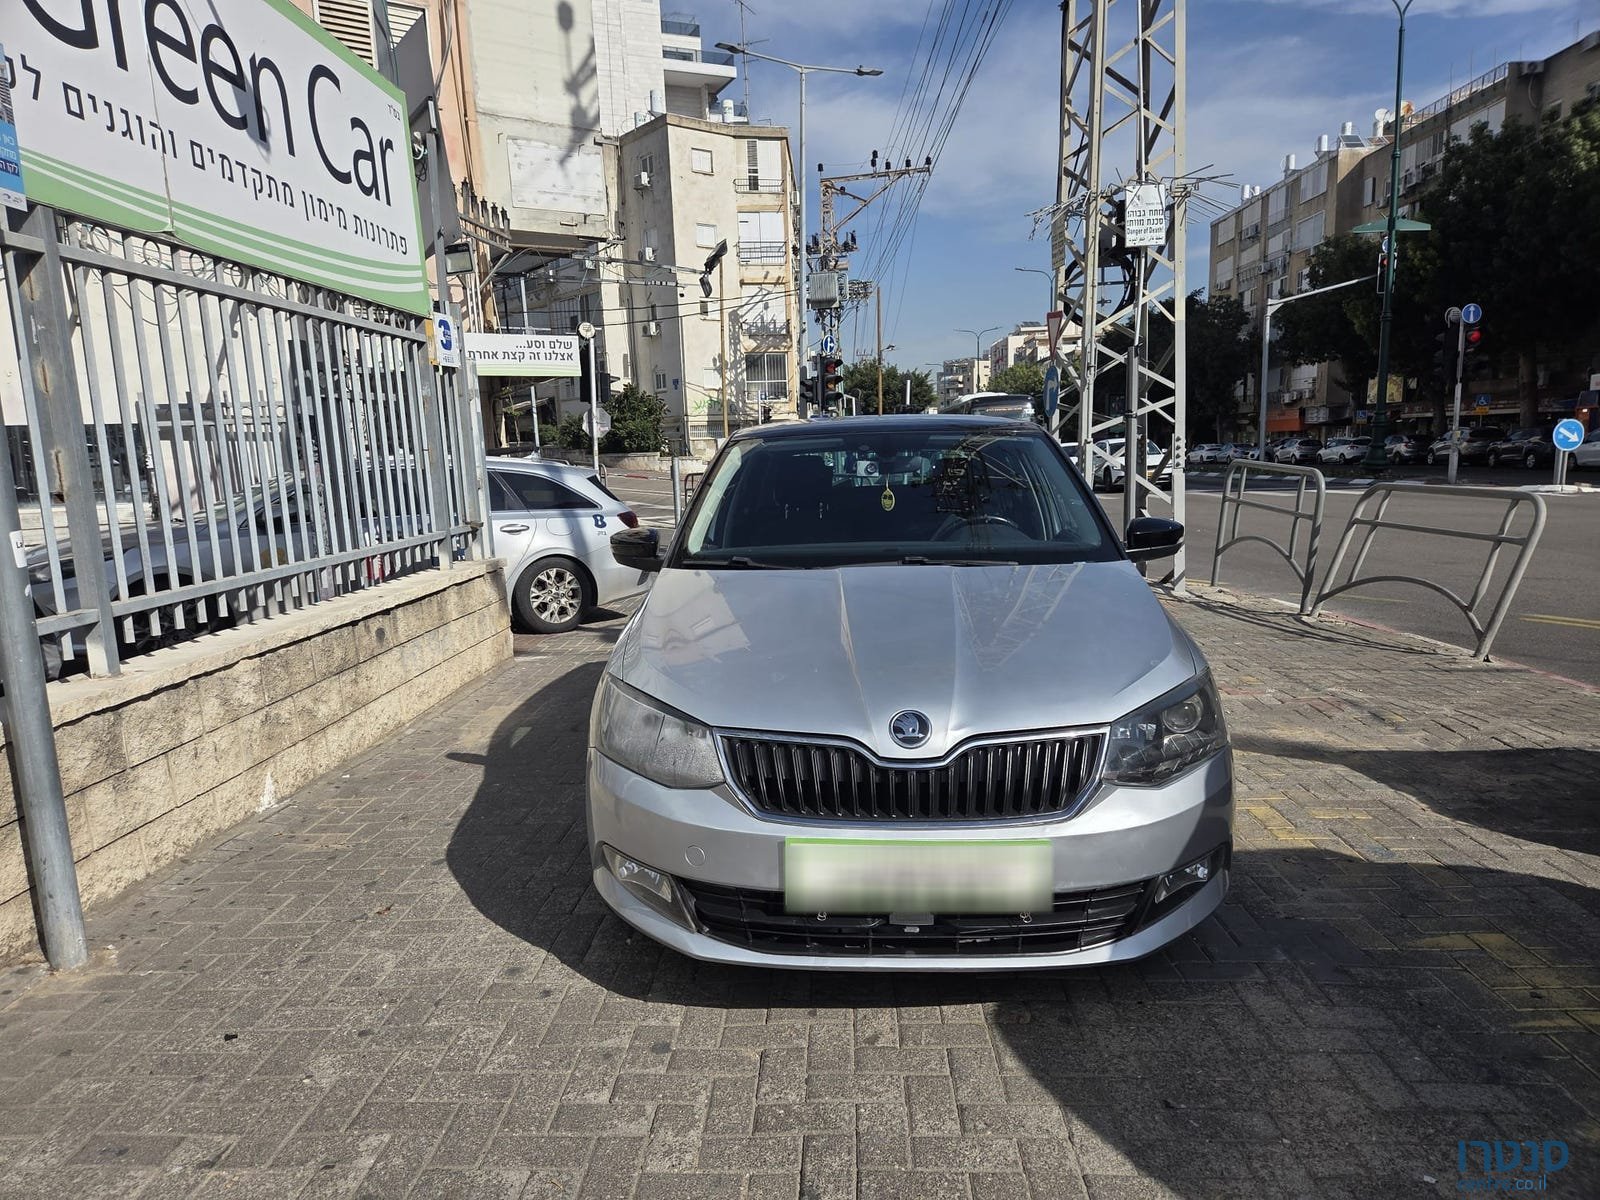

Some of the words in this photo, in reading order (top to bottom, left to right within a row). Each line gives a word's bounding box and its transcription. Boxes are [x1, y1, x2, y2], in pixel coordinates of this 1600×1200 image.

[62, 81, 178, 158] והוגנים
[308, 64, 393, 206] Car
[189, 139, 294, 208] מתקדמים
[301, 188, 348, 232] מימון
[353, 212, 408, 256] פתרונות
[515, 339, 546, 349] וסע...
[549, 339, 573, 349] שלם
[467, 350, 499, 360] אחרת
[502, 350, 526, 363] קצת
[529, 351, 541, 360] זה
[544, 351, 574, 361] אצלנו
